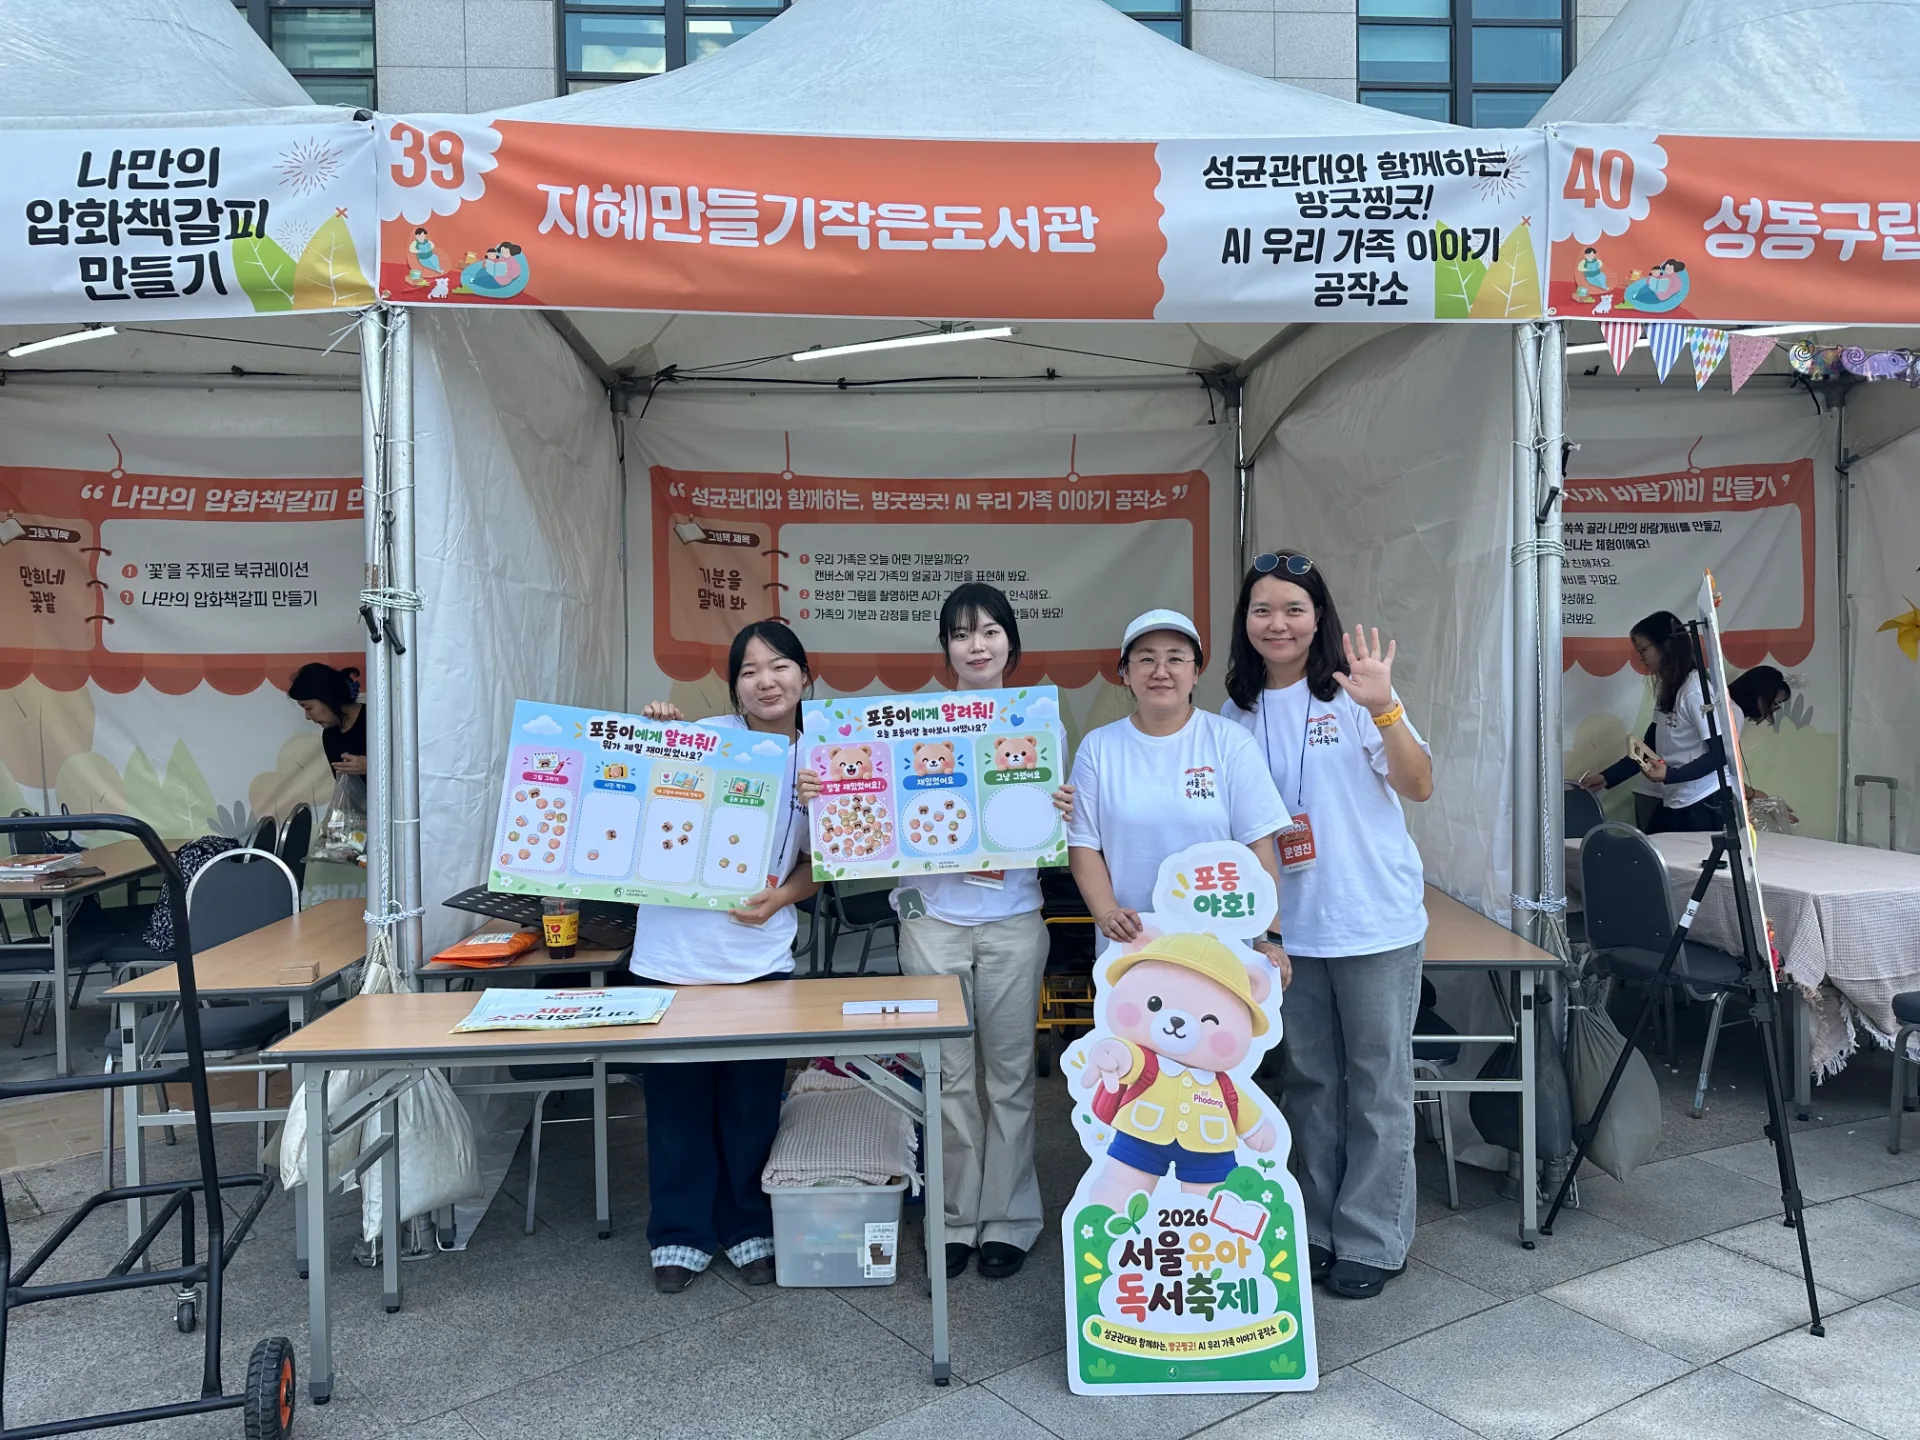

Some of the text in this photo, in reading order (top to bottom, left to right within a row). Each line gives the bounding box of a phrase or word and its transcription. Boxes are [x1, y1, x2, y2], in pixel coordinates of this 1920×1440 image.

[77, 146, 221, 190] 나만의
[390, 122, 464, 189] 39
[1202, 147, 1511, 190] 성균관대와 함께하는,
[1563, 146, 1635, 211] 40
[1295, 183, 1434, 221] 방긋찡긋!
[25, 198, 269, 246] 압화책갈피
[536, 182, 1100, 254] 지혜만들기작은도서관
[1221, 226, 1501, 265] AI 우리 가족 이야기
[79, 250, 229, 301] 만들기
[1313, 270, 1409, 308] 공작소
[204, 488, 339, 514] 압화책갈피
[787, 489, 866, 512] 함께하는,
[871, 489, 950, 511] 방긋찡긋!
[954, 492, 971, 511] AI
[976, 491, 1012, 511] 우리
[1017, 490, 1053, 511] 가족
[1058, 489, 1110, 511] 이야기
[1608, 477, 1705, 503] 바람개비
[1586, 522, 1607, 535] 골라
[1608, 522, 1637, 535] 나만의
[1640, 521, 1691, 534] 바람개비를
[1692, 520, 1722, 533] 만들고,
[1595, 538, 1651, 551] 체험이에요!
[185, 562, 230, 579] 주제로
[234, 561, 309, 579] 북큐레이션
[814, 553, 834, 566] 우리
[837, 553, 867, 566] 가족은
[869, 553, 889, 566] 오늘
[891, 553, 911, 566] 어떤
[914, 553, 969, 566] 기분일까요?
[1572, 557, 1614, 569] 친해져요.
[20, 566, 66, 587] 만희네
[699, 566, 743, 591] 기분을
[814, 570, 1030, 582] 캔버스에 우리 가족의 얼굴과 기분을 표현해 봐요.
[1589, 574, 1620, 586] 꾸며요.
[29, 591, 56, 614] 꽃밭
[142, 591, 189, 607] 나만의
[194, 591, 268, 608] 압화책갈피
[272, 590, 318, 607] 만들기
[697, 588, 748, 611] 말해 봐
[814, 589, 845, 601] 완성한
[847, 589, 877, 602] 그림을
[880, 589, 919, 602] 촬영하면
[921, 590, 941, 602] AI가
[1009, 589, 1051, 601] 인식해요.
[814, 608, 845, 620] 가족의
[848, 609, 877, 620] 기분과
[880, 609, 909, 621] 감정을
[911, 609, 931, 621] 담은
[1042, 607, 1064, 619] 봐요!
[867, 702, 994, 727] 포동이에게 알려줘!
[589, 720, 718, 752] 포동이에게 알려줘!
[877, 730, 890, 739] 오늘
[892, 728, 920, 738] 포동이랑
[602, 740, 621, 751] 뭐가
[624, 743, 643, 754] 제일
[1284, 842, 1312, 859] 운영진
[1194, 861, 1240, 892] 포동
[1193, 891, 1255, 918] 야호!
[1193, 1093, 1224, 1109] Phodong
[1157, 1208, 1209, 1228] 2026
[1118, 1230, 1252, 1277] 서울유아
[1115, 1270, 1259, 1323] 독서축제
[1104, 1327, 1138, 1346] 성균관대와
[1207, 1340, 1221, 1351] 우리
[1221, 1337, 1236, 1348] 가족
[1235, 1331, 1257, 1345] 이야기
[1257, 1325, 1278, 1341] 공작소
